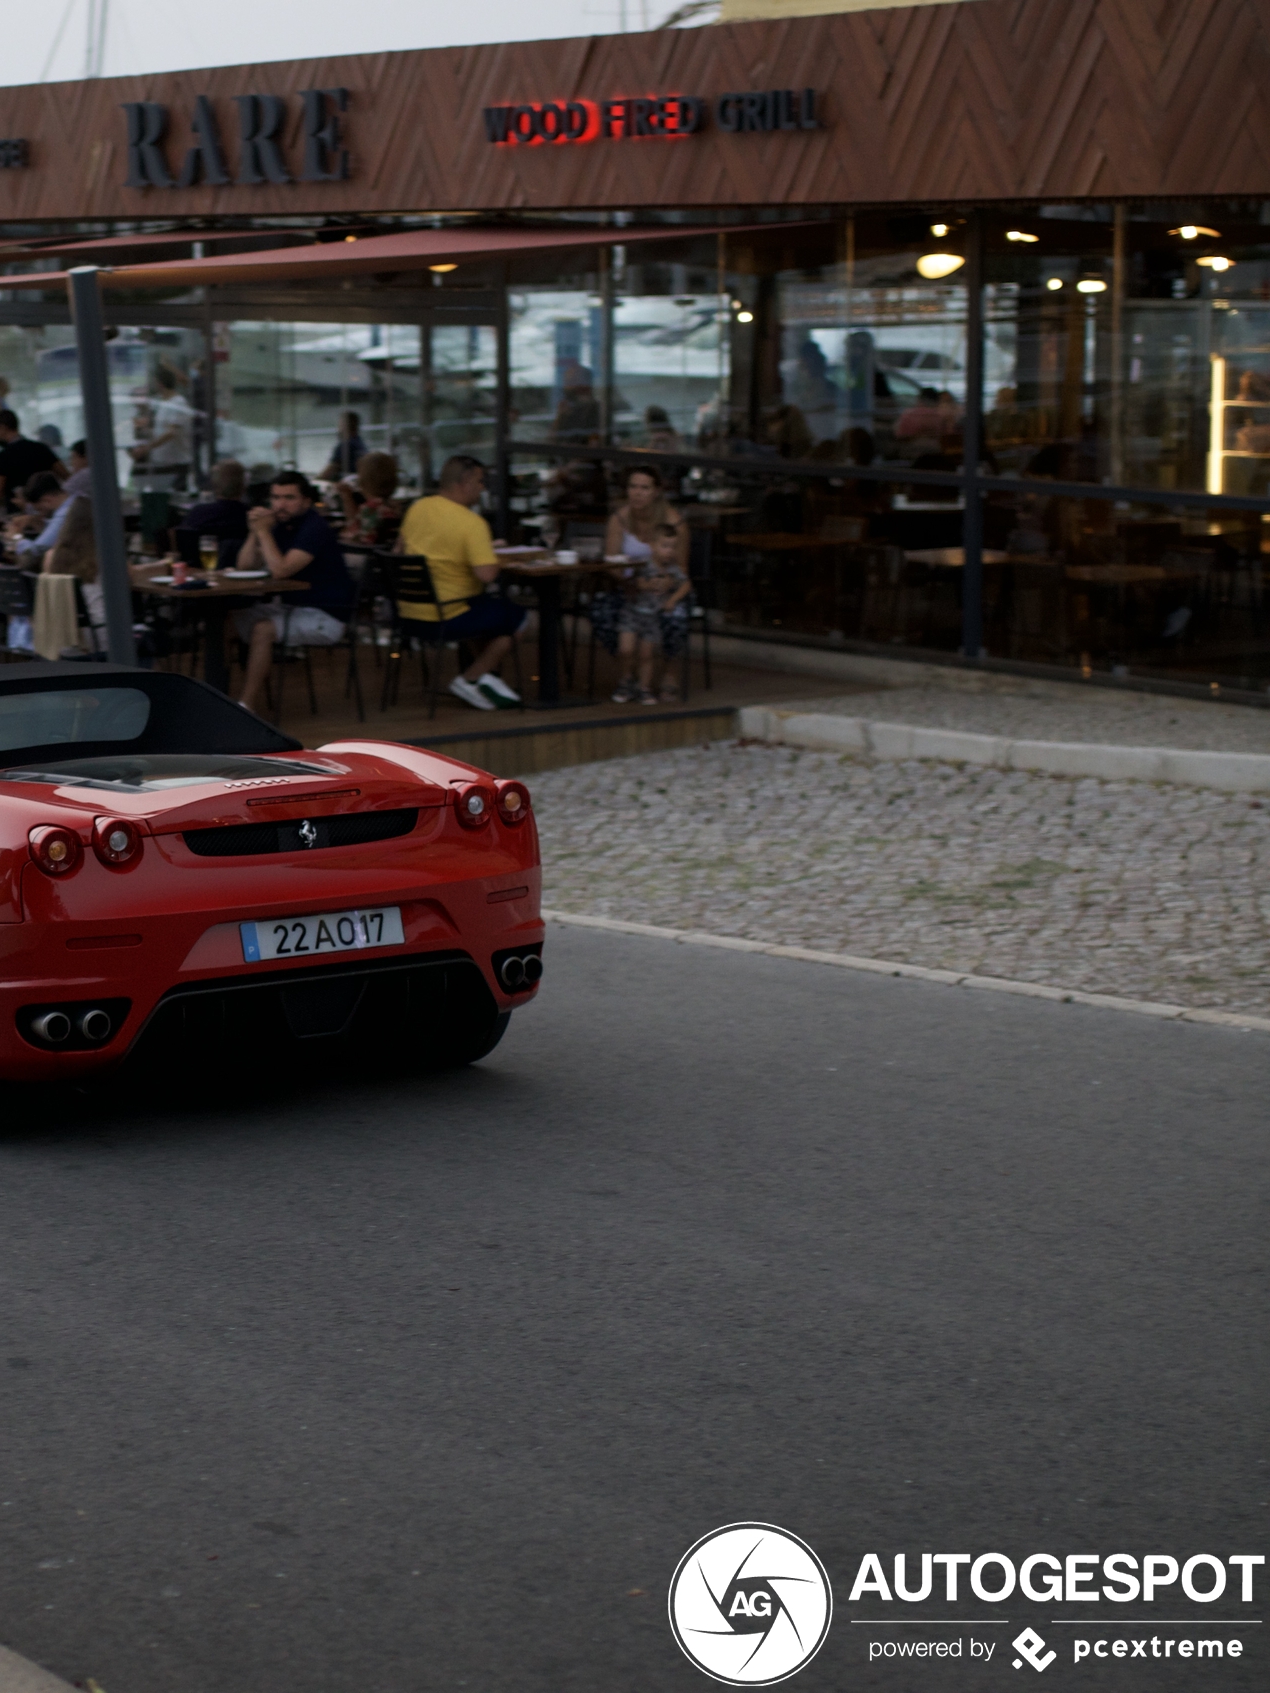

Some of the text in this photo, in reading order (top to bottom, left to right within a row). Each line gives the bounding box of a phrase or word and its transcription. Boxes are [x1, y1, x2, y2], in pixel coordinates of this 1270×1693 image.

[120, 88, 349, 188] RARE
[484, 88, 818, 142] WOOD FIRED GRILL
